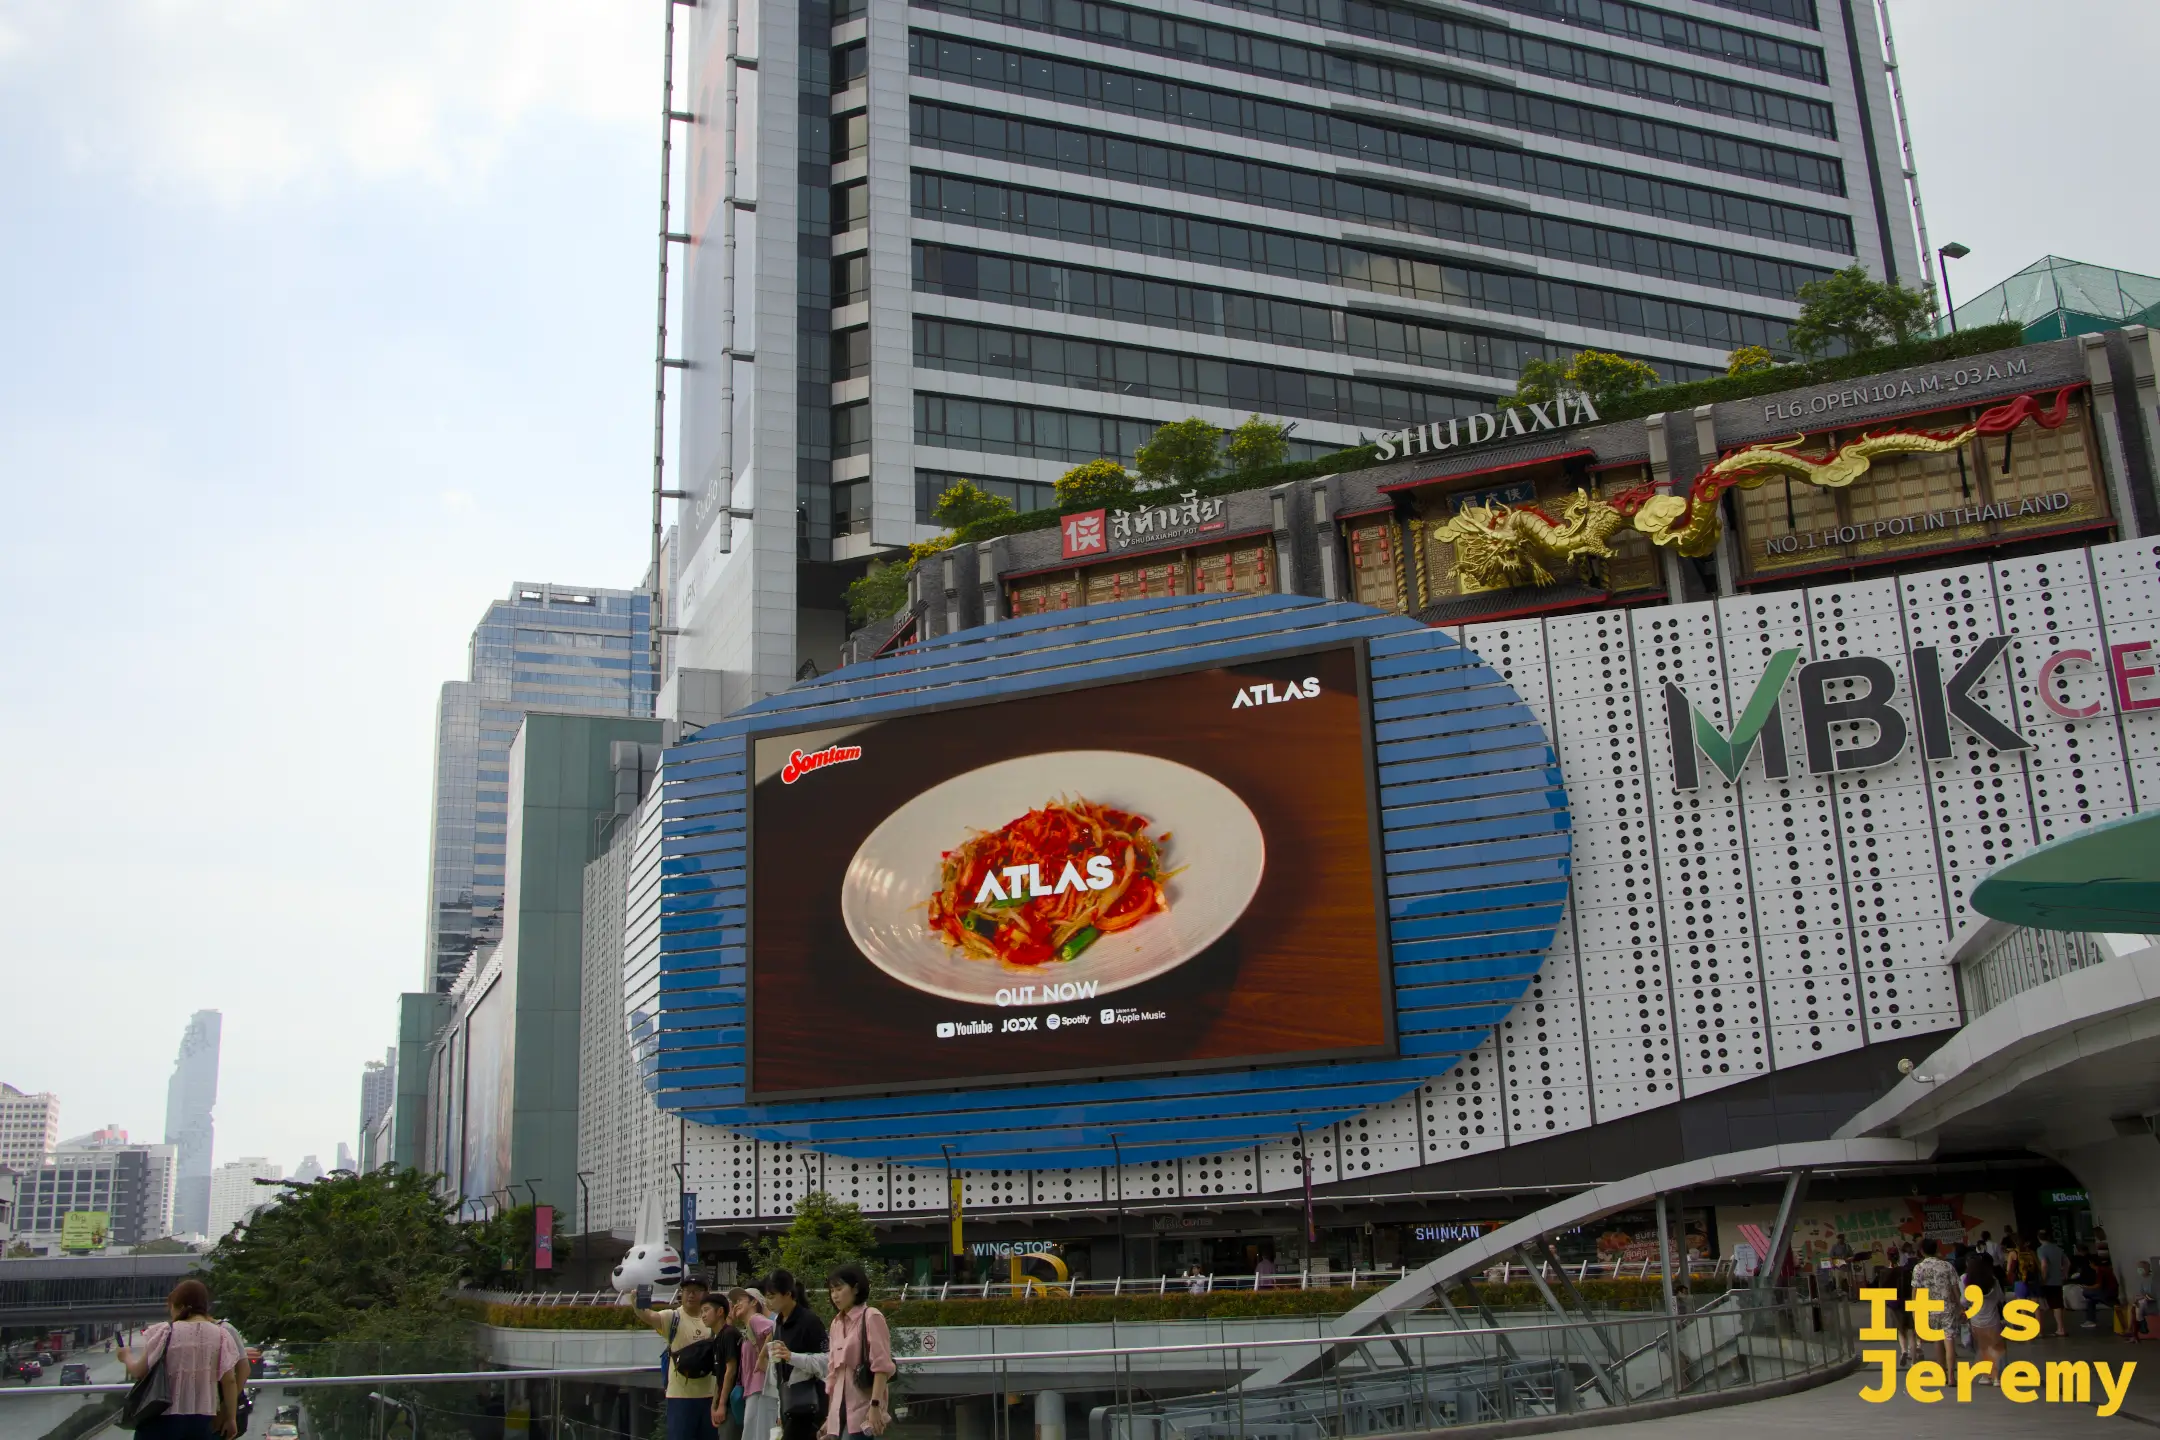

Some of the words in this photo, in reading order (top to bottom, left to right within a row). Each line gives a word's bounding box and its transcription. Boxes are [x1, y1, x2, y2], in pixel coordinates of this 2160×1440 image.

[1811, 387, 1869, 413] OPEN
[1824, 523, 1868, 546] HOT
[1874, 515, 1917, 538] POT
[1923, 511, 1945, 531] IN
[1949, 491, 2069, 526] THAILAND
[1183, 527, 1197, 535] POT
[1231, 677, 1321, 709] ATLAS
[1664, 634, 2036, 792] MBK
[2037, 640, 2160, 720] CE
[781, 745, 862, 784] Somtam
[974, 855, 1114, 904] ATLAS
[995, 986, 1036, 1007] OUT
[1043, 980, 1099, 1002] NOW
[1001, 1016, 1038, 1033] JOOX
[1061, 1014, 1091, 1026] Spotify
[1116, 1013, 1140, 1024] Apple
[1141, 1011, 1166, 1021] Music
[956, 1020, 993, 1036] YouTube
[2052, 1191, 2084, 1202] KBank
[1849, 1227, 1900, 1243] ENTER
[971, 1242, 1010, 1257] WING
[1014, 1241, 1053, 1256] STOP
